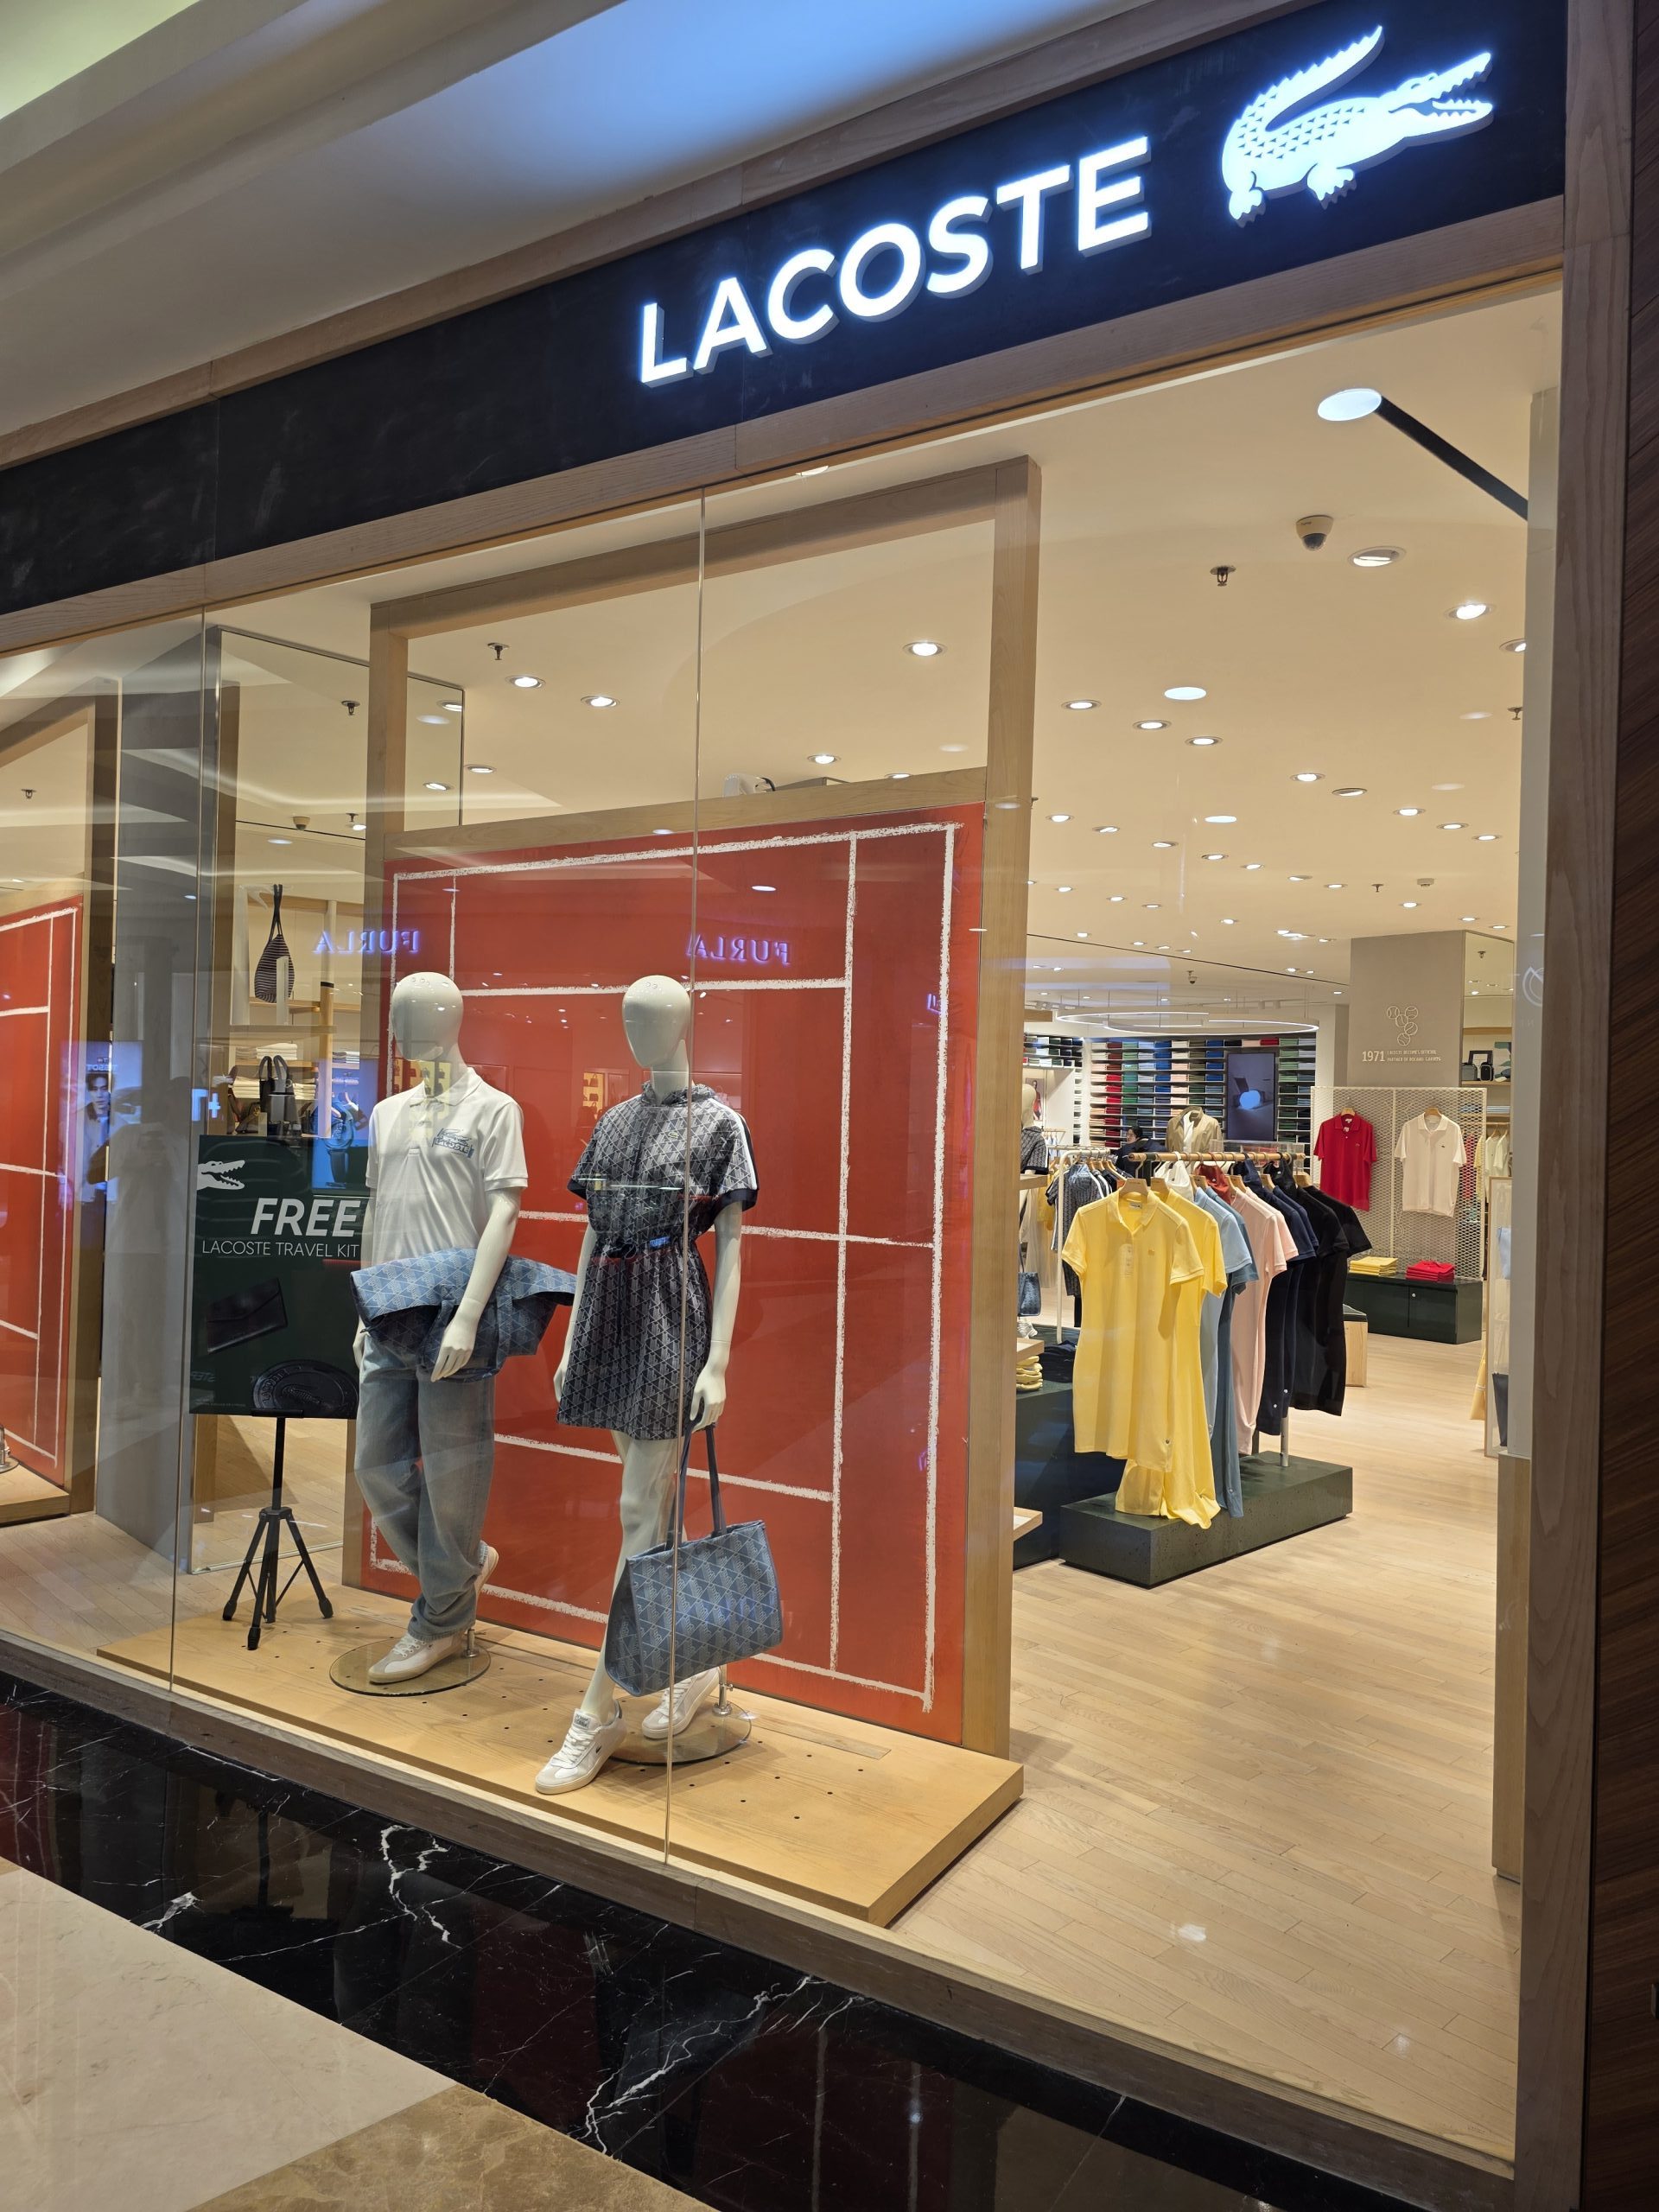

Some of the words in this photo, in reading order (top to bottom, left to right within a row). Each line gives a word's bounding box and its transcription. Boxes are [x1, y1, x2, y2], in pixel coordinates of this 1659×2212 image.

[641, 136, 1150, 385] LACOSTE
[1362, 1050, 1385, 1062] 1971
[251, 1198, 361, 1237] FREE
[202, 1240, 271, 1255] LACOSTE
[276, 1242, 333, 1257] TRAVEL
[337, 1243, 360, 1258] KIT
